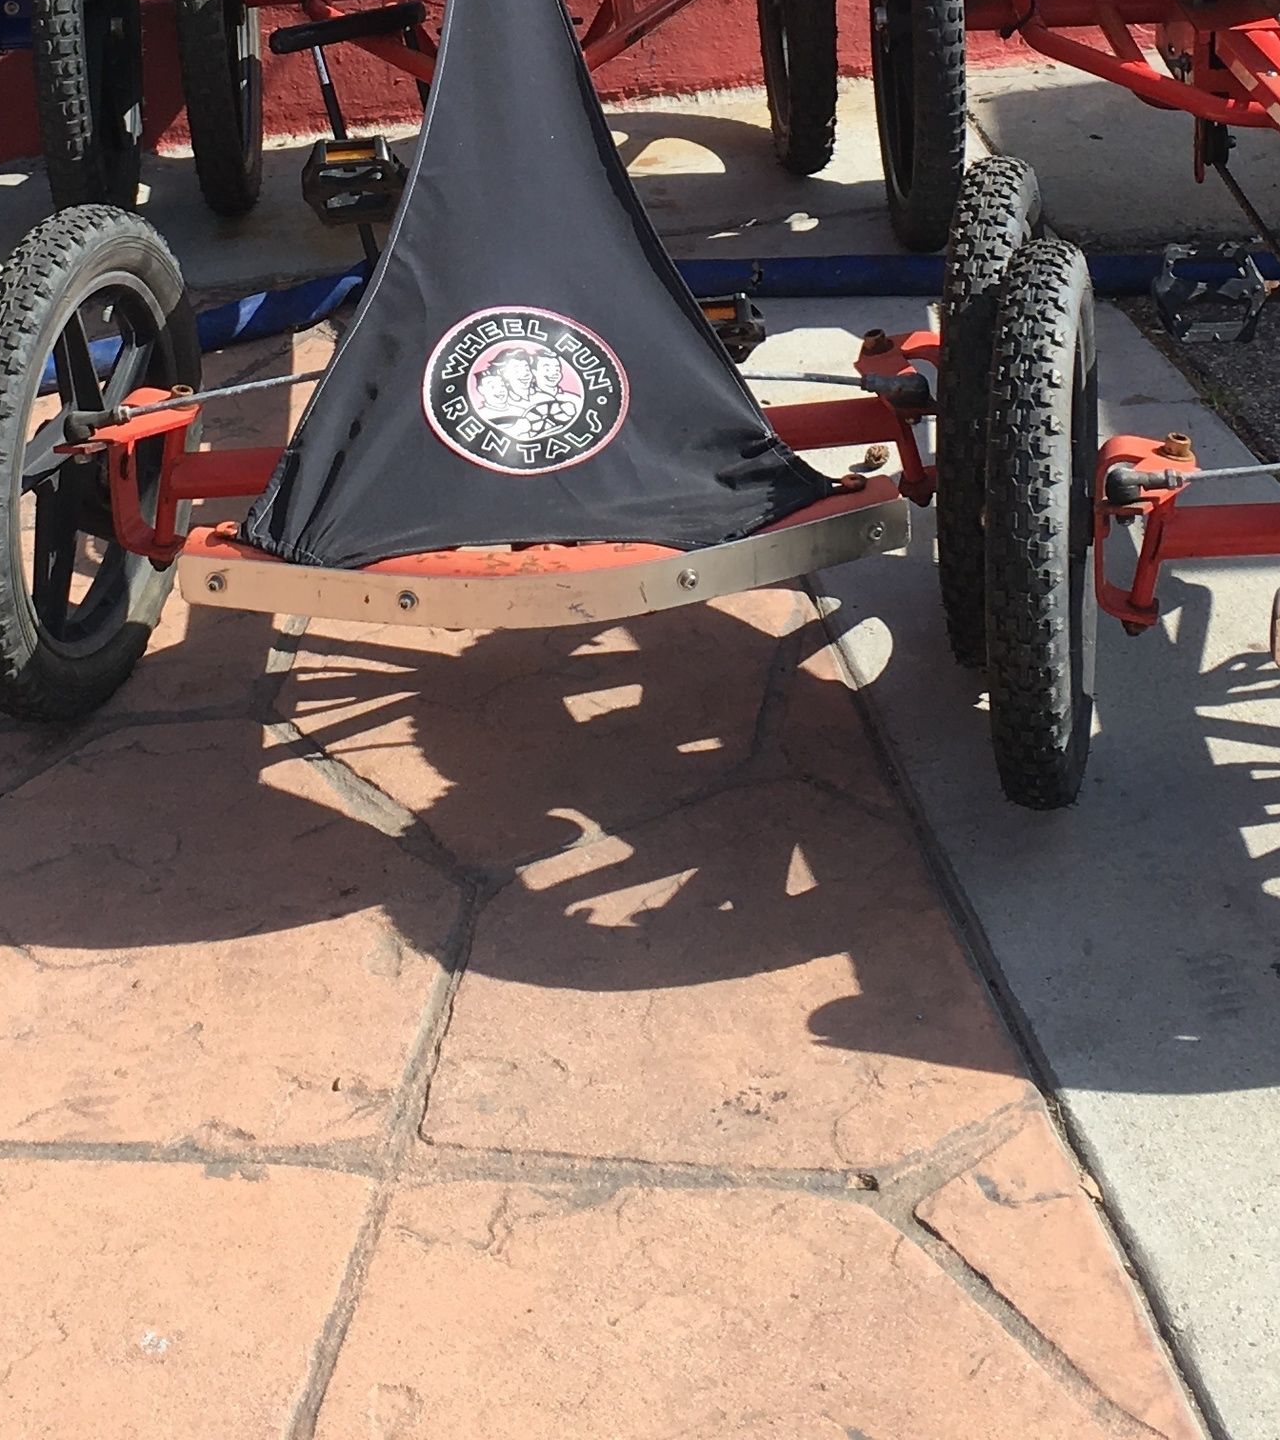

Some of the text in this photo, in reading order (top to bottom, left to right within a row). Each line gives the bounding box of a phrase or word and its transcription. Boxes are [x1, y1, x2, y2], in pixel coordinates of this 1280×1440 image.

[441, 318, 611, 391] WHEEL FUN
[441, 396, 603, 463] RENTALS
